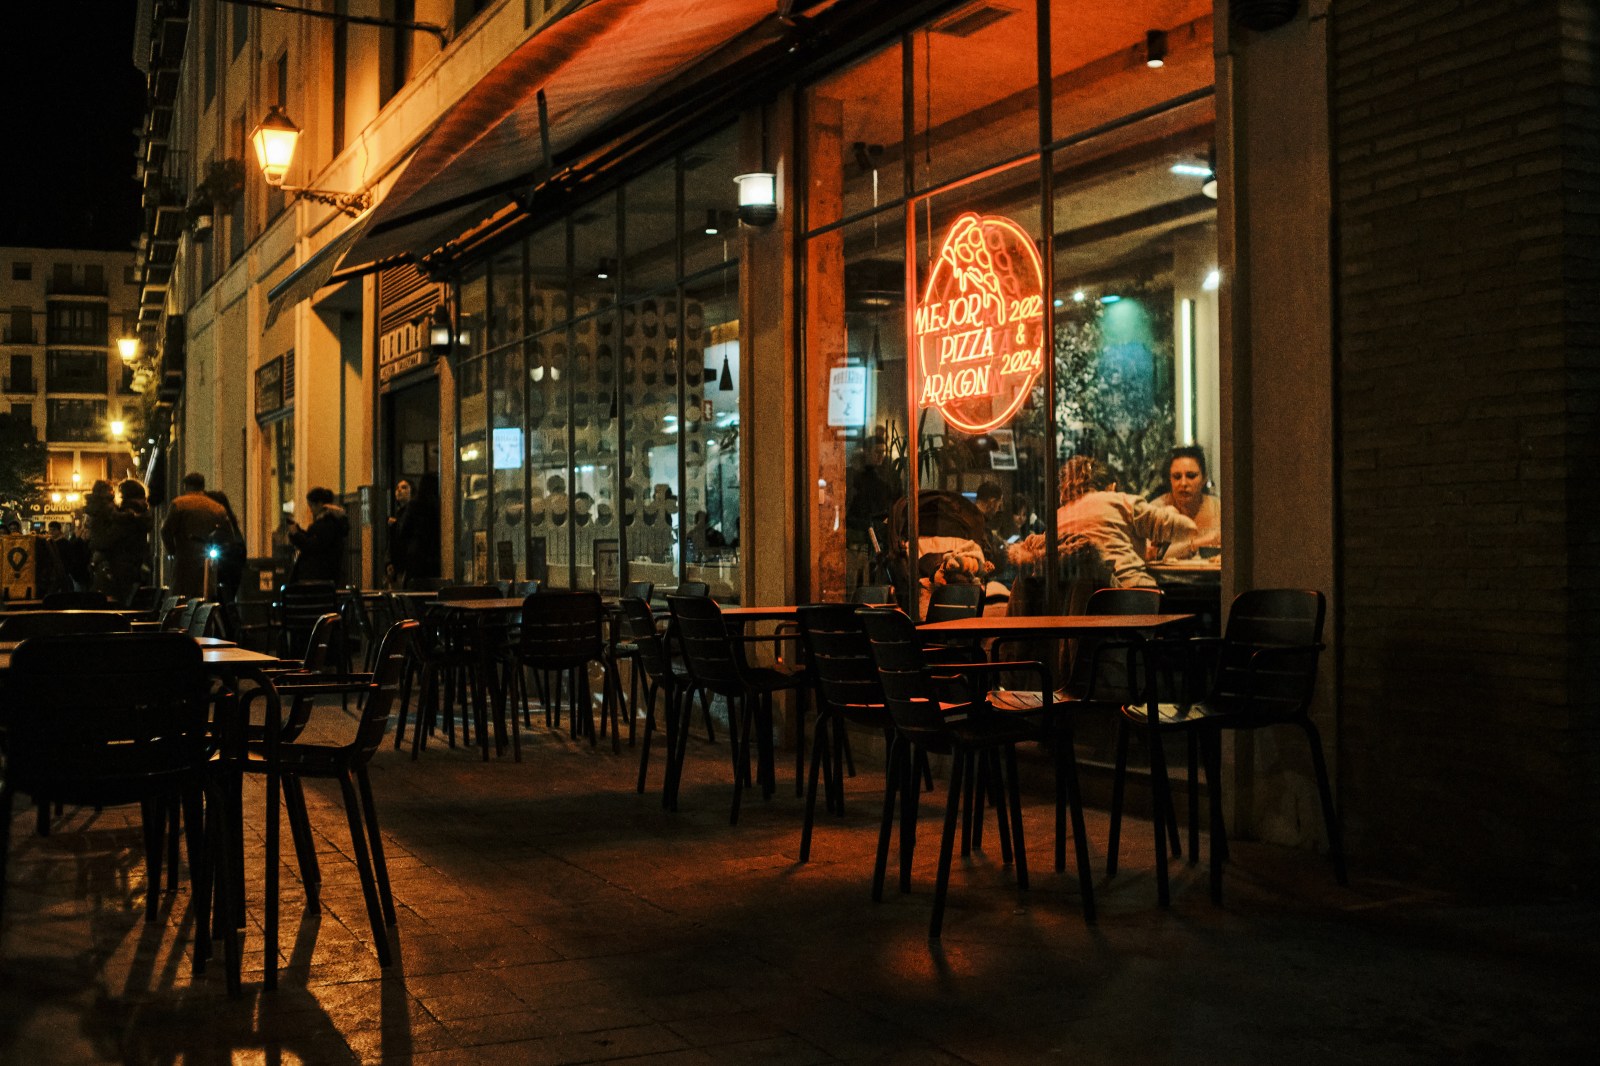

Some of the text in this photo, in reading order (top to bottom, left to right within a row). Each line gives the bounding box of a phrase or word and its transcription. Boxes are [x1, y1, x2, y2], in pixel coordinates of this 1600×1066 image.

[915, 294, 983, 335] MEJOR
[940, 327, 994, 364] PIZZA
[1016, 323, 1025, 344] &
[1000, 347, 1040, 375] 2024
[919, 365, 991, 406] ARAGON
[44, 504, 71, 514] punto
